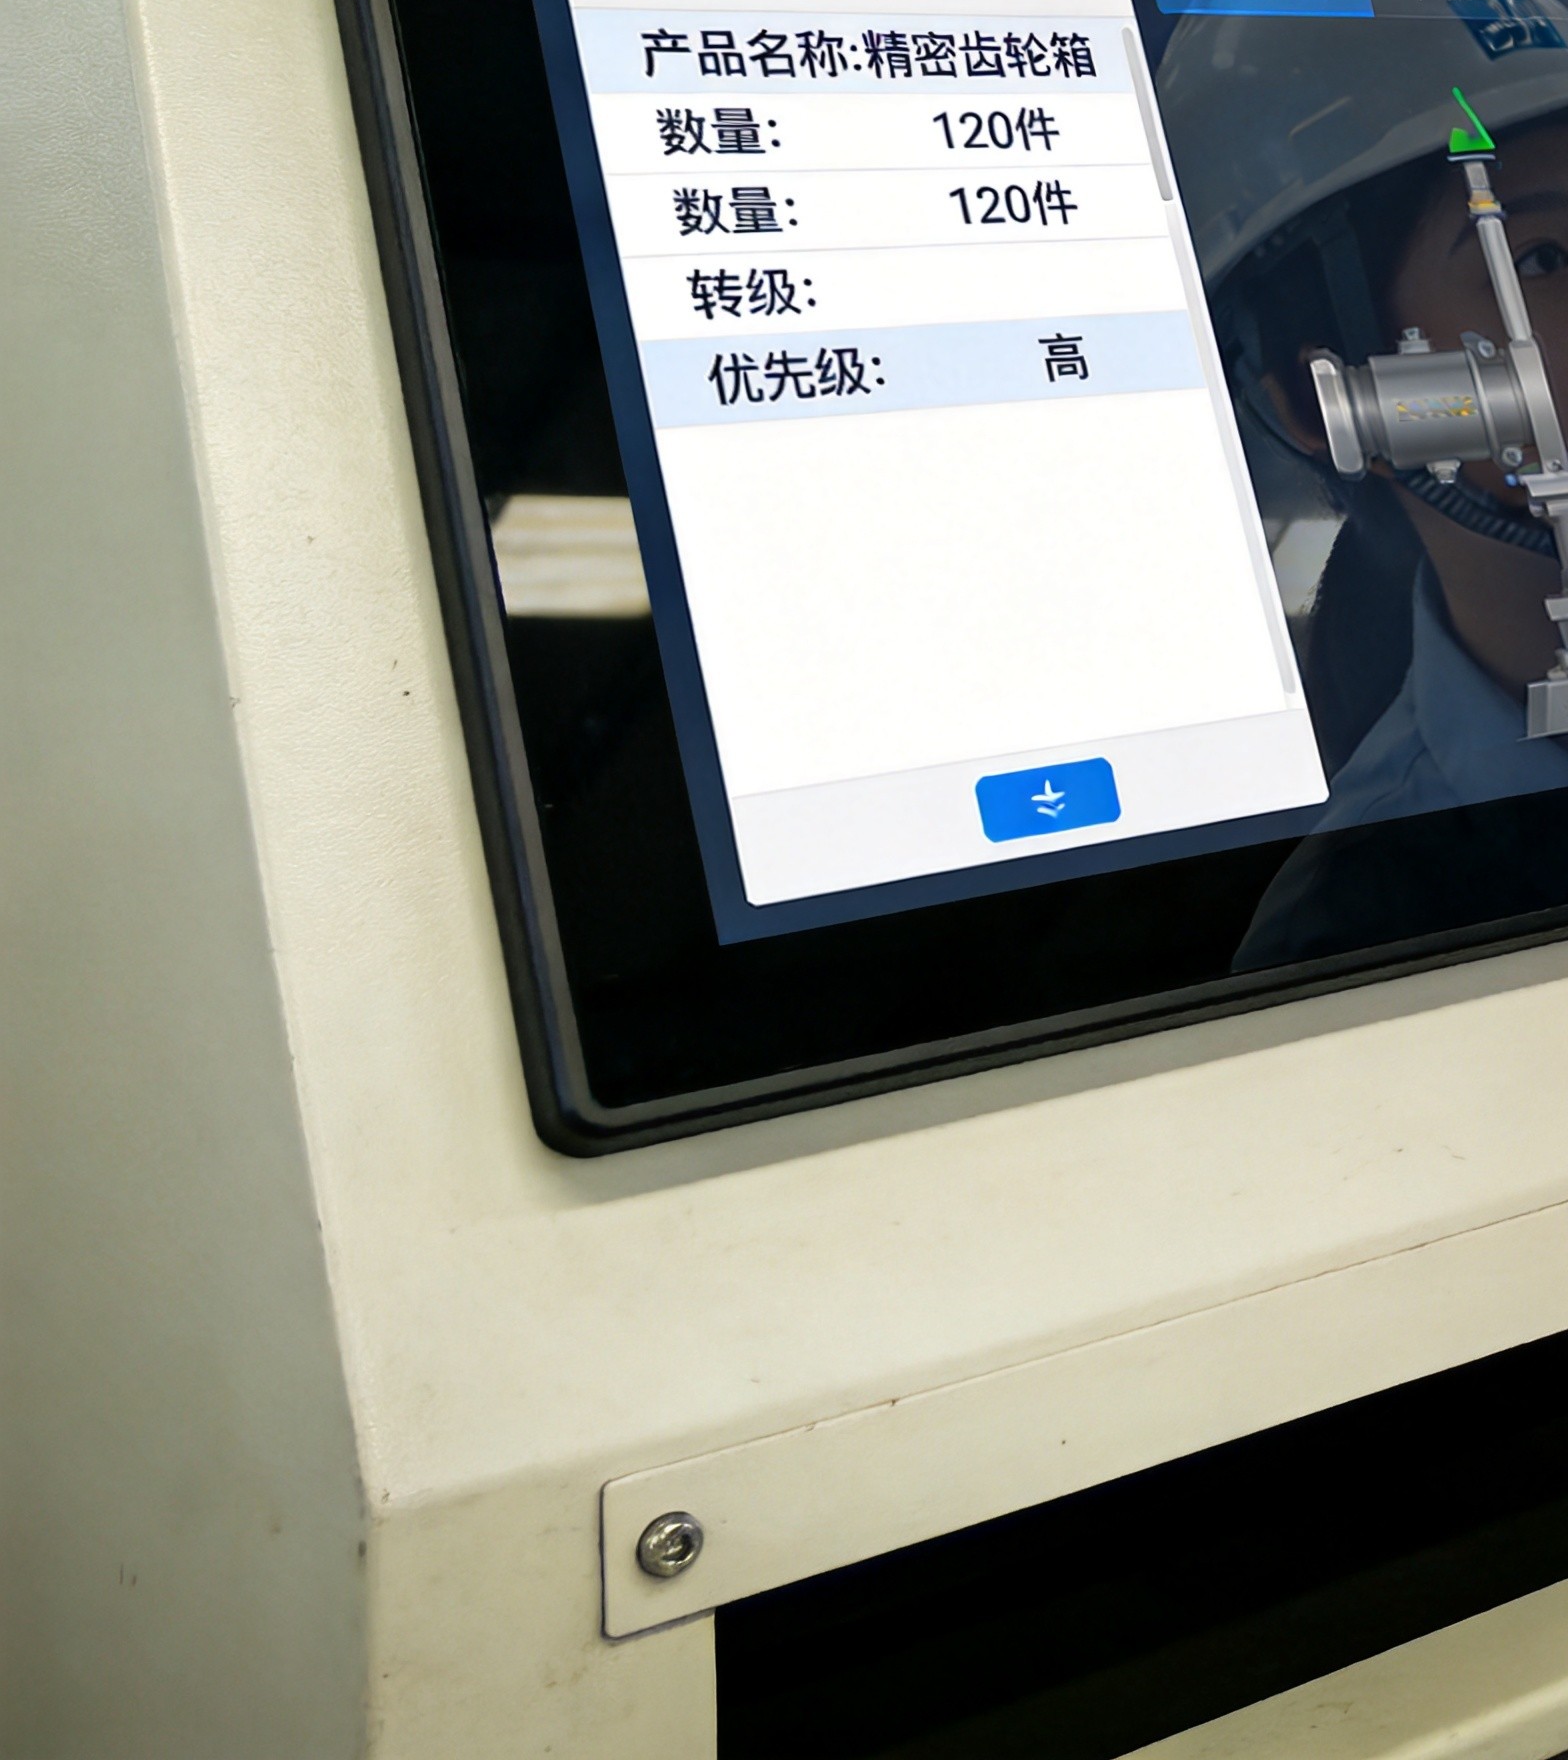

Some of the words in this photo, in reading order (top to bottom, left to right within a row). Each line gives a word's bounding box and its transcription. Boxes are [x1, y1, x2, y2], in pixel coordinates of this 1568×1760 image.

[932, 107, 1061, 153] 120件
[949, 180, 1079, 227] 120件
[1037, 331, 1091, 384] 高
